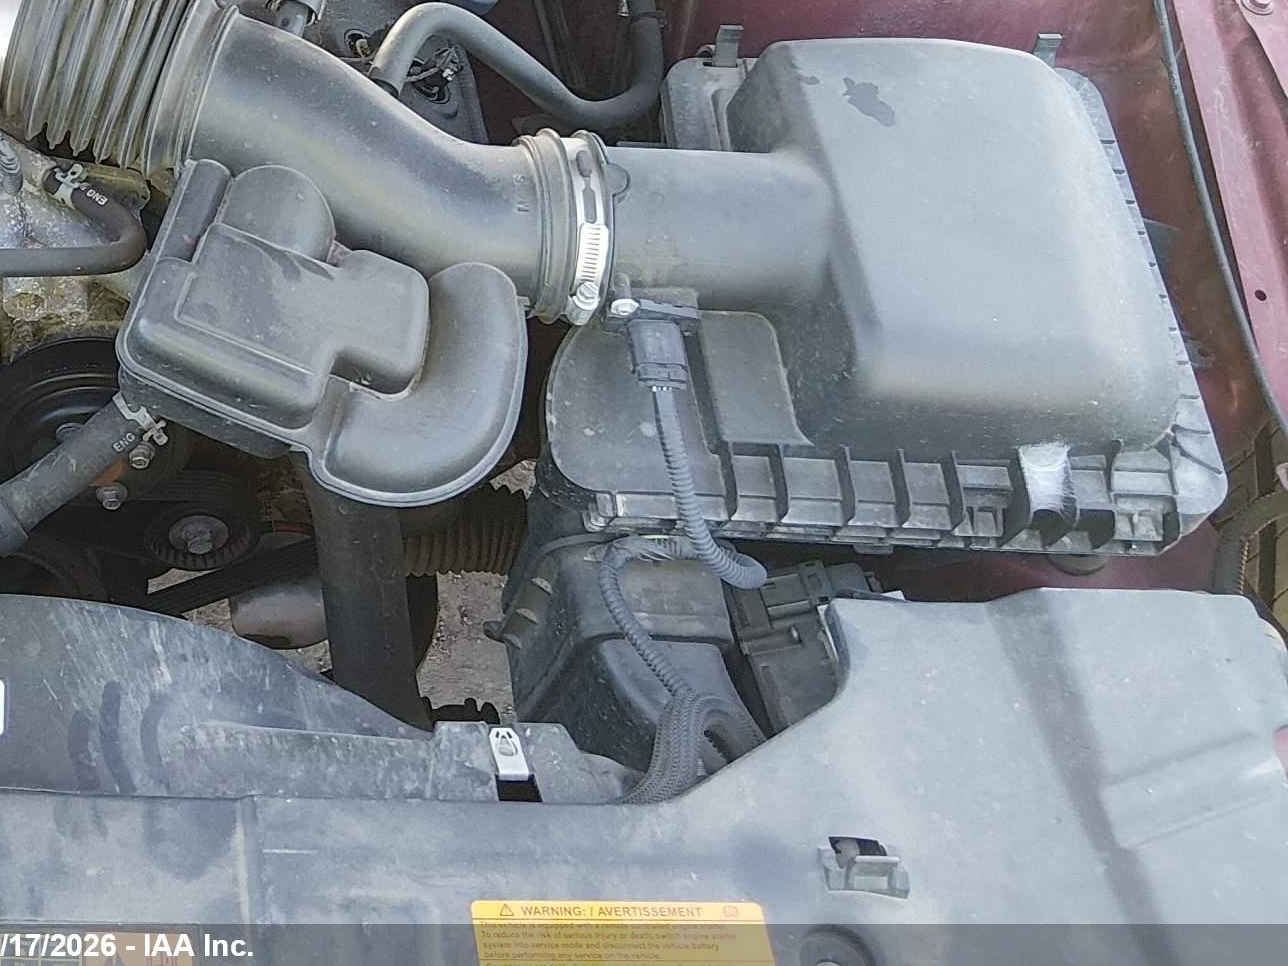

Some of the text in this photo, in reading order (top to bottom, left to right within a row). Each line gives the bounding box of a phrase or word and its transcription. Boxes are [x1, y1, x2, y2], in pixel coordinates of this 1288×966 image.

[86, 188, 108, 206] ENG
[113, 432, 136, 452] ENG
[520, 905, 586, 917] WARNING:
[598, 906, 702, 918] AVERTISSEMENT
